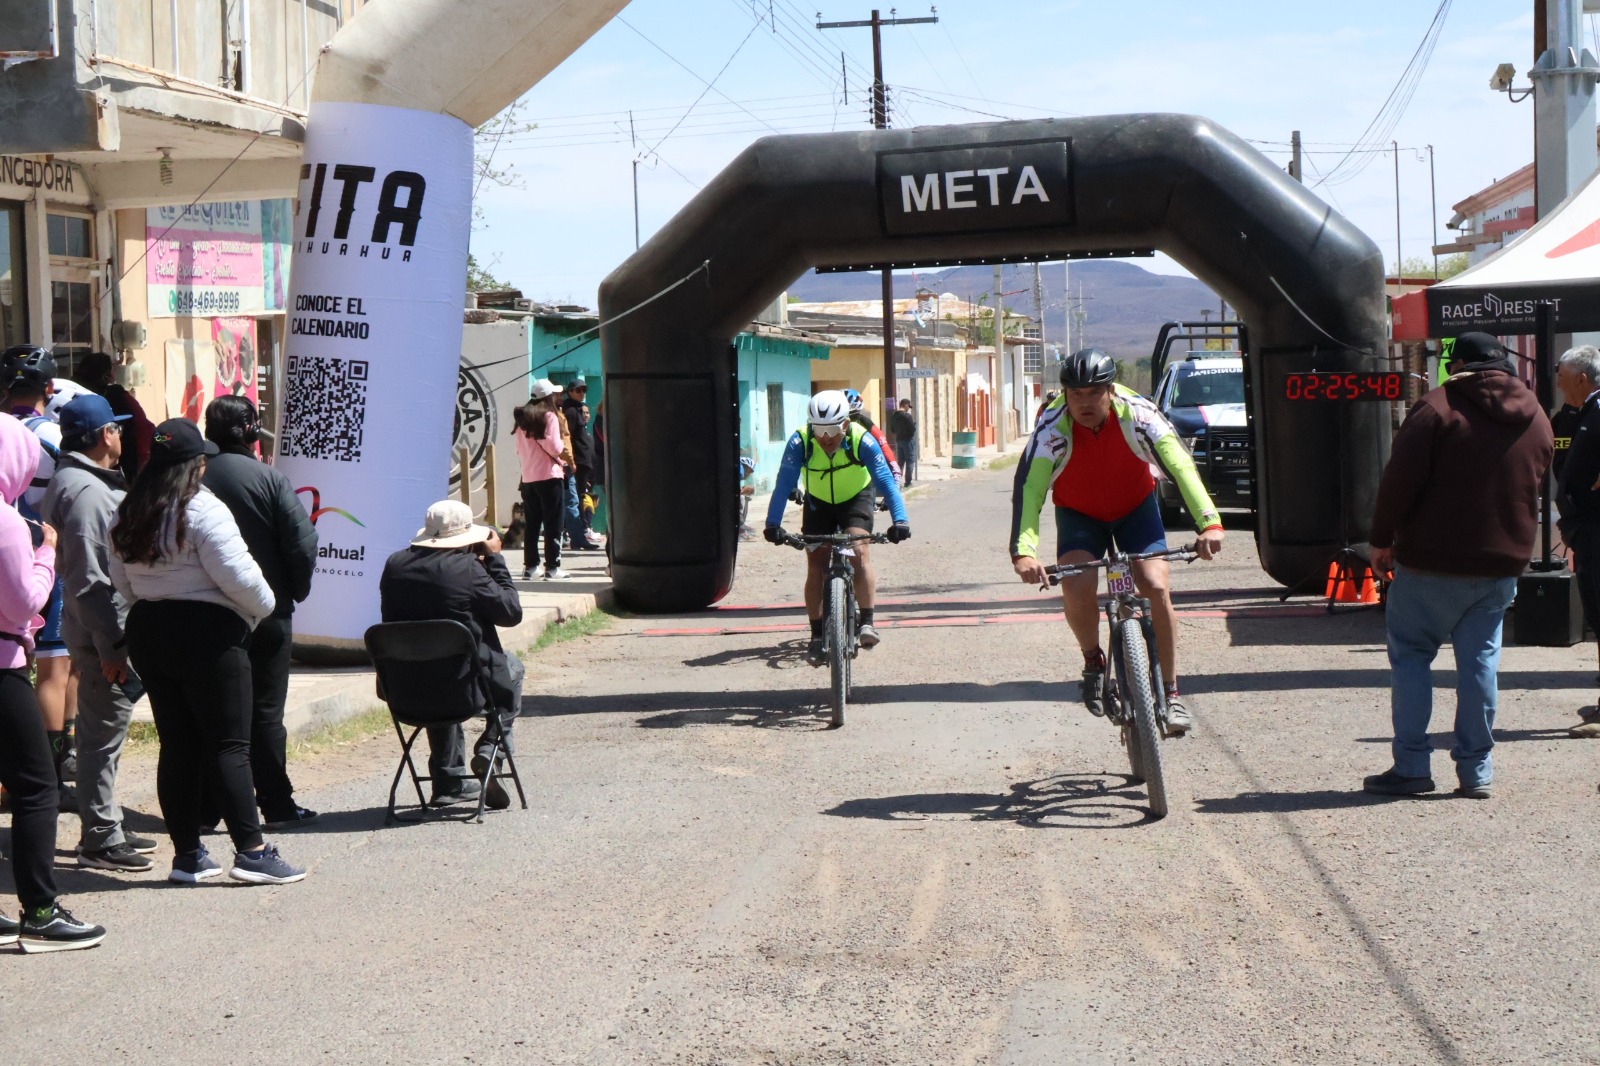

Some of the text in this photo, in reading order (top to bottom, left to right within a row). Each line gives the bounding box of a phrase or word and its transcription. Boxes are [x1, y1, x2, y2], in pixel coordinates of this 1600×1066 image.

[0, 156, 74, 193] NCEDORA
[900, 165, 1050, 212] META
[296, 163, 426, 246] ITA
[292, 241, 412, 262] IHUAHUA
[177, 291, 240, 311] 648-469-8996
[296, 294, 367, 315] CONOCE EL
[1442, 298, 1561, 319] RACE REST
[291, 317, 370, 340] CALENDARIO
[1286, 374, 1401, 399] 02:25:48
[317, 543, 365, 561] ahua!
[314, 567, 364, 577] ONÓCELO
[1109, 575, 1133, 593] 189
